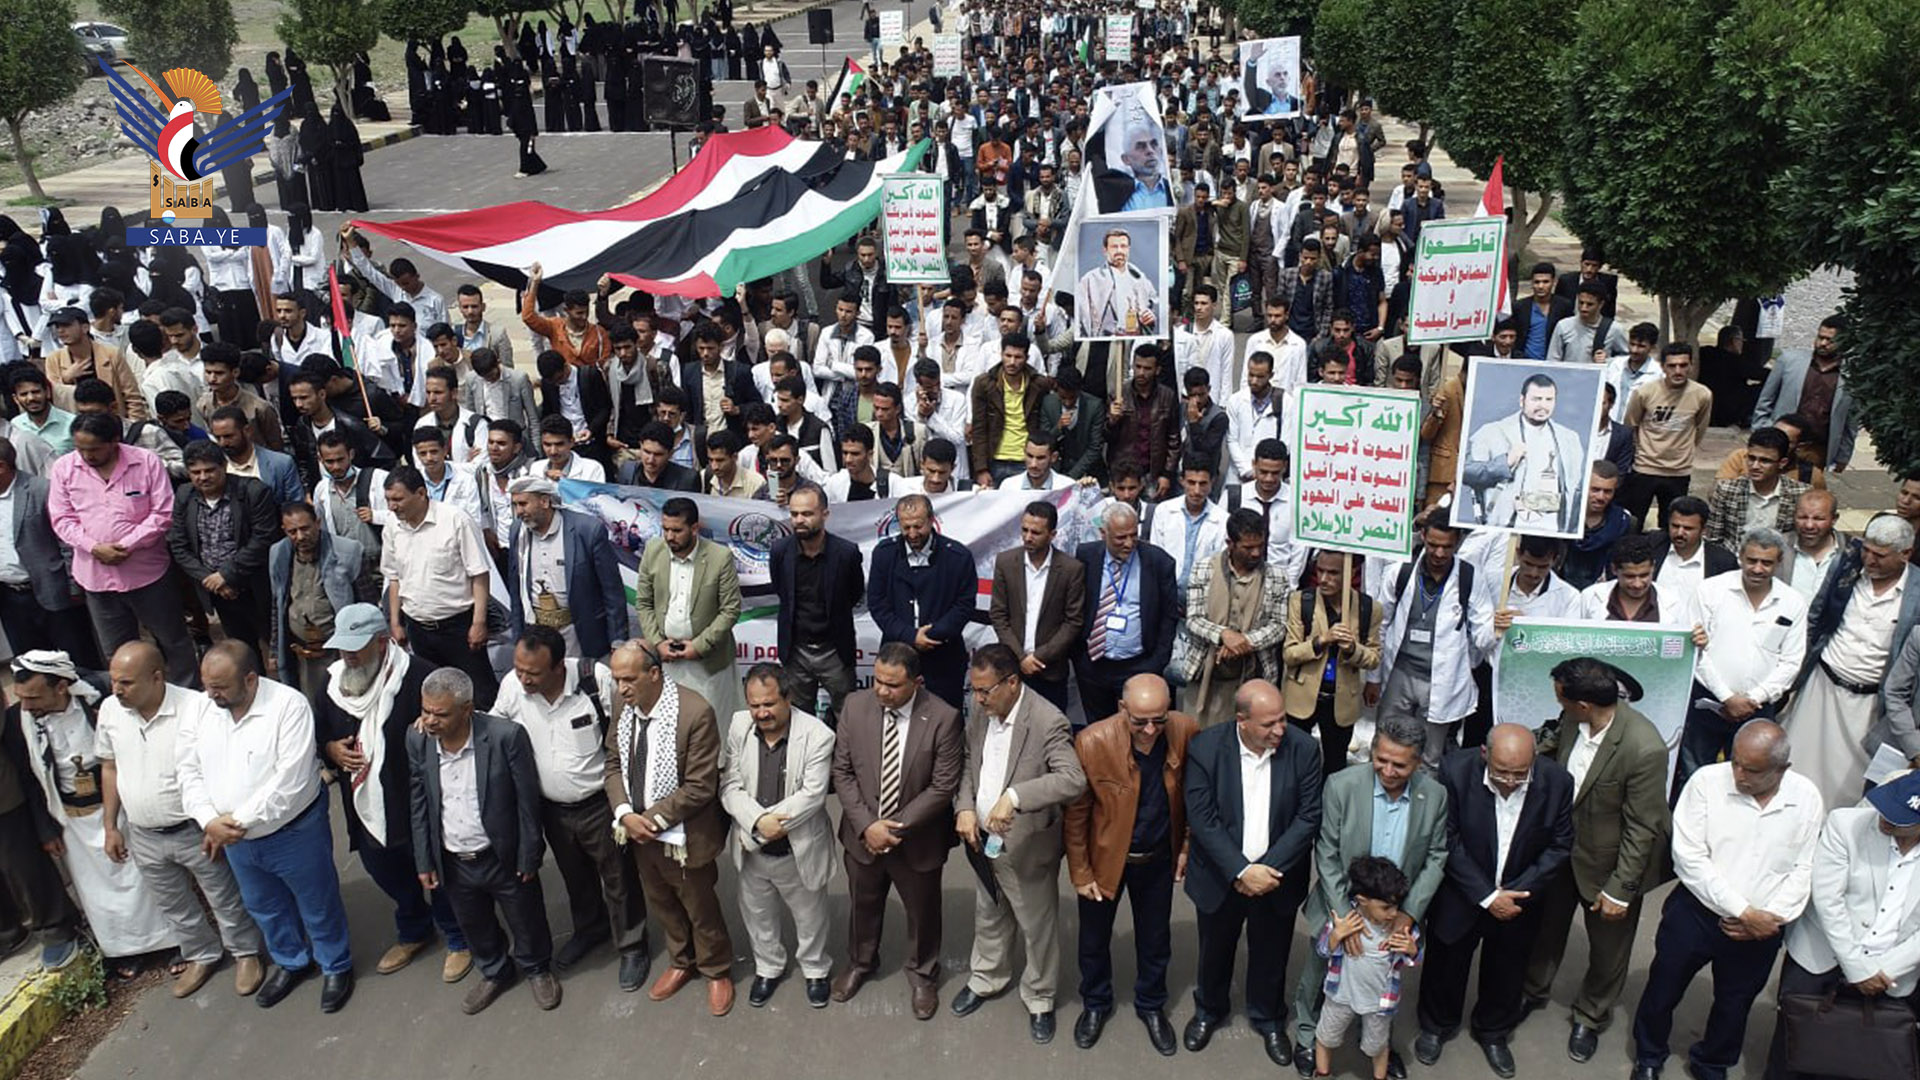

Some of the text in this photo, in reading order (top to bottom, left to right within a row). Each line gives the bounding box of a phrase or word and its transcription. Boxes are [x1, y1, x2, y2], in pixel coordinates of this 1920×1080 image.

[1448, 288, 1455, 304] و
[1370, 405, 1413, 432] الله
[1362, 443, 1410, 462] الموت
[1361, 470, 1407, 488] الموت
[1301, 488, 1406, 514] اللعنة على اليهود
[1357, 517, 1404, 542] النصر
